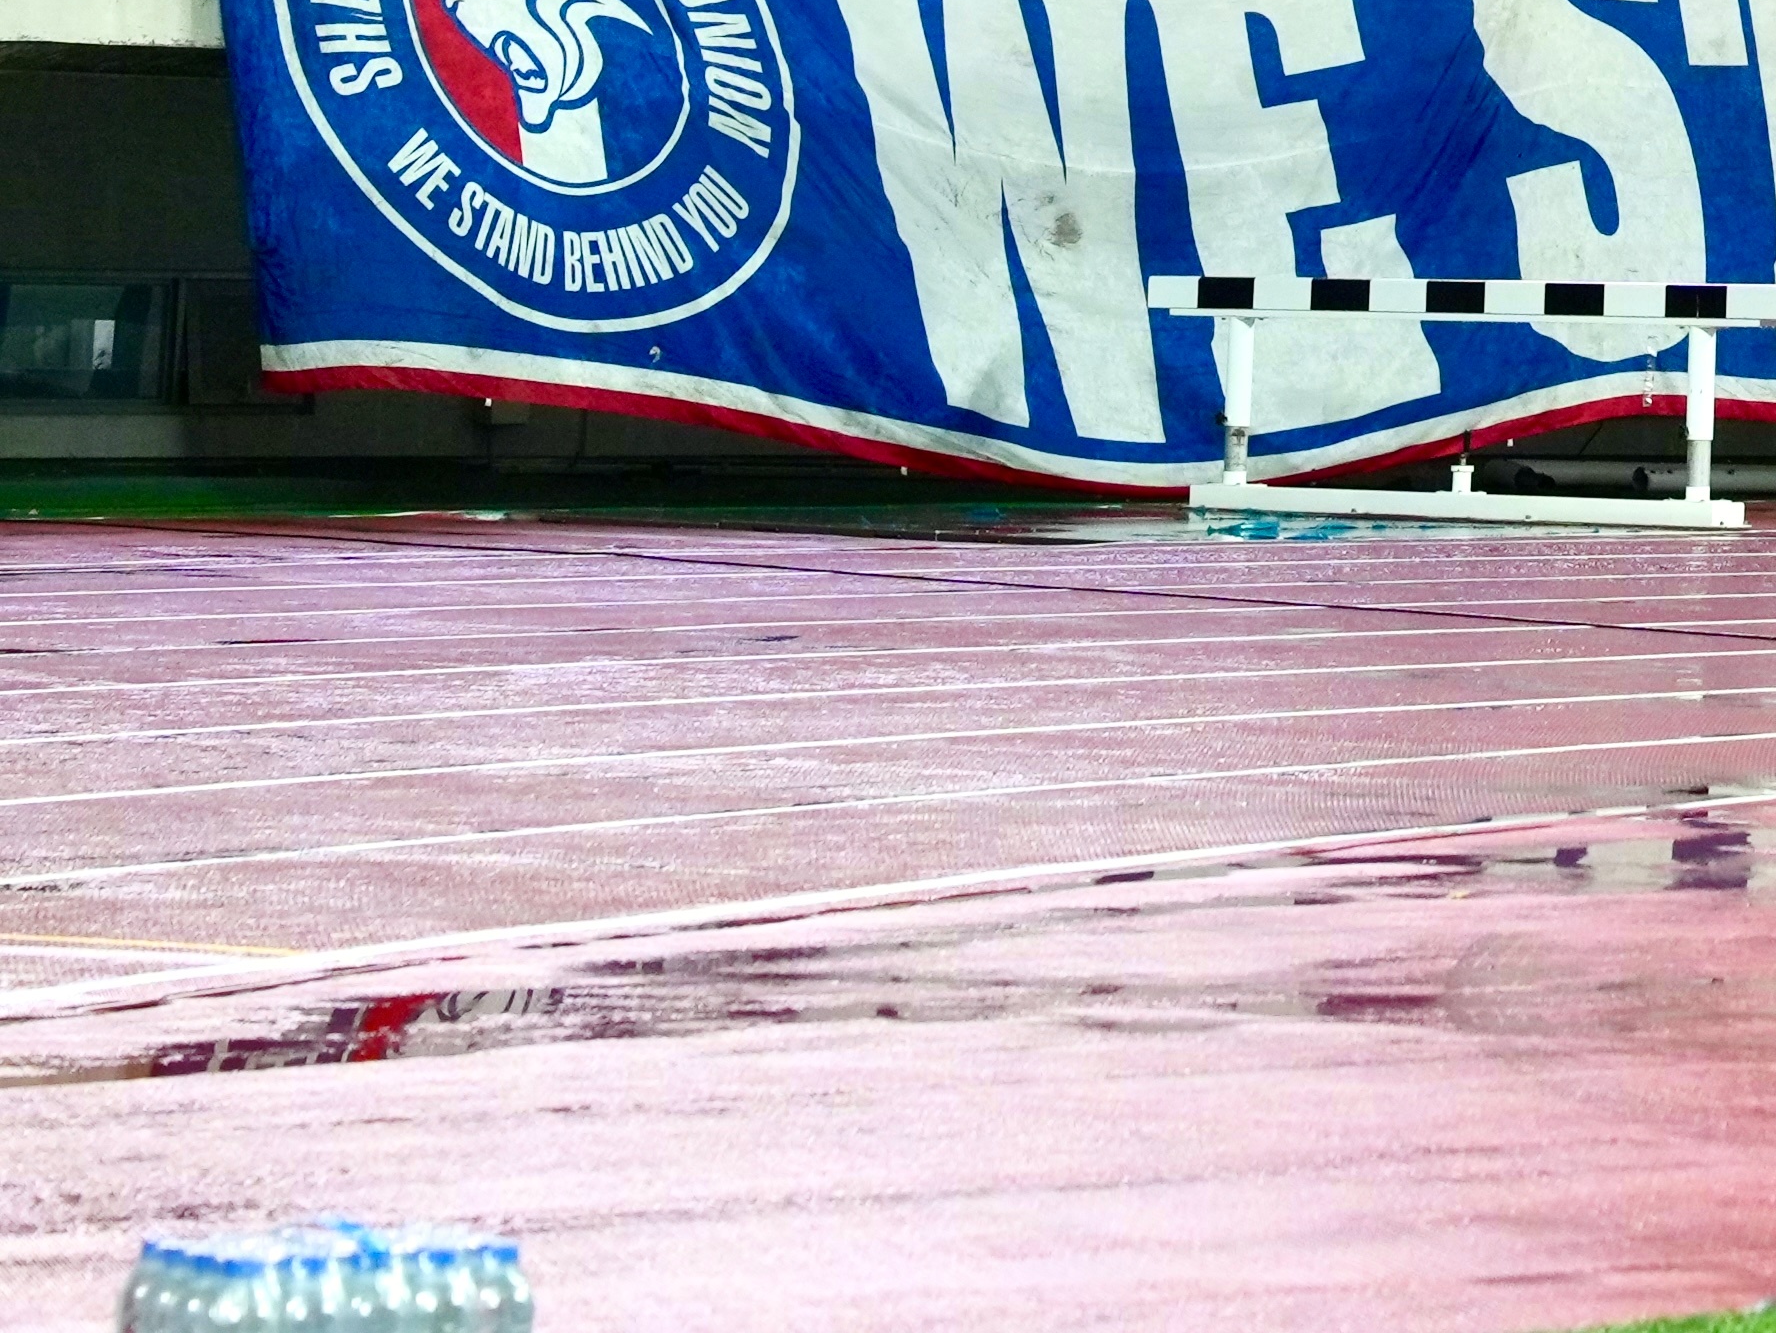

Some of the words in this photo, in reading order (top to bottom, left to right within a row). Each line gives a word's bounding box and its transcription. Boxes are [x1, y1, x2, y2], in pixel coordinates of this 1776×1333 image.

[387, 127, 458, 212] WE
[447, 181, 555, 288] STAND
[562, 214, 695, 293] BEHIND
[679, 165, 750, 254] YOU
